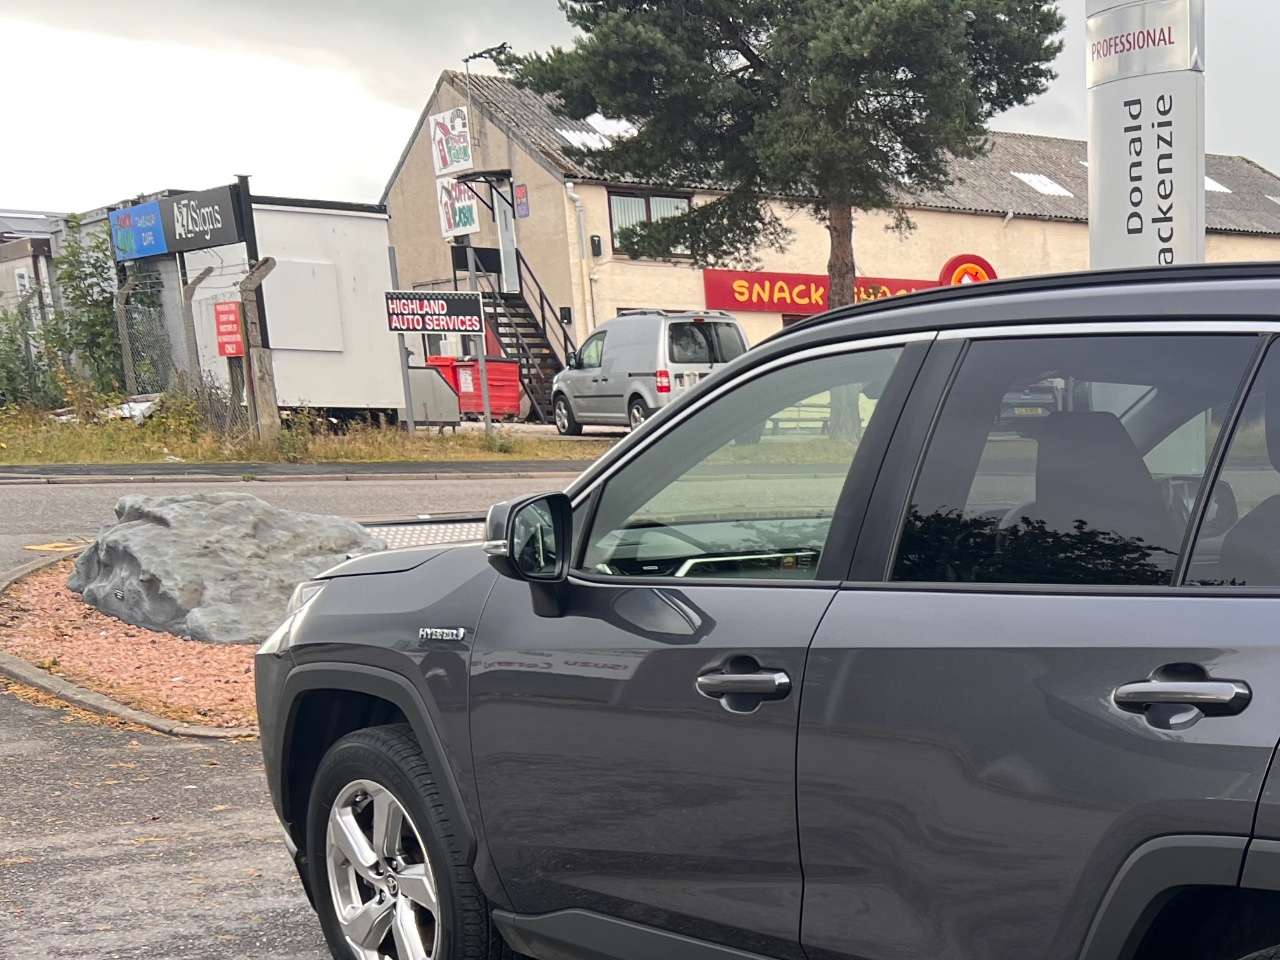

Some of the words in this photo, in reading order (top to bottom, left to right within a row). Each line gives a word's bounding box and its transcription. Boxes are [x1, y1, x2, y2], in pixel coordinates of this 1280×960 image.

[1091, 26, 1175, 61] PROFESSIONAL
[1123, 98, 1143, 235] Donald
[732, 279, 825, 305] SNACK
[388, 298, 448, 315] HIGHLAND
[391, 314, 422, 330] AUTO
[424, 315, 481, 331] SERVICES
